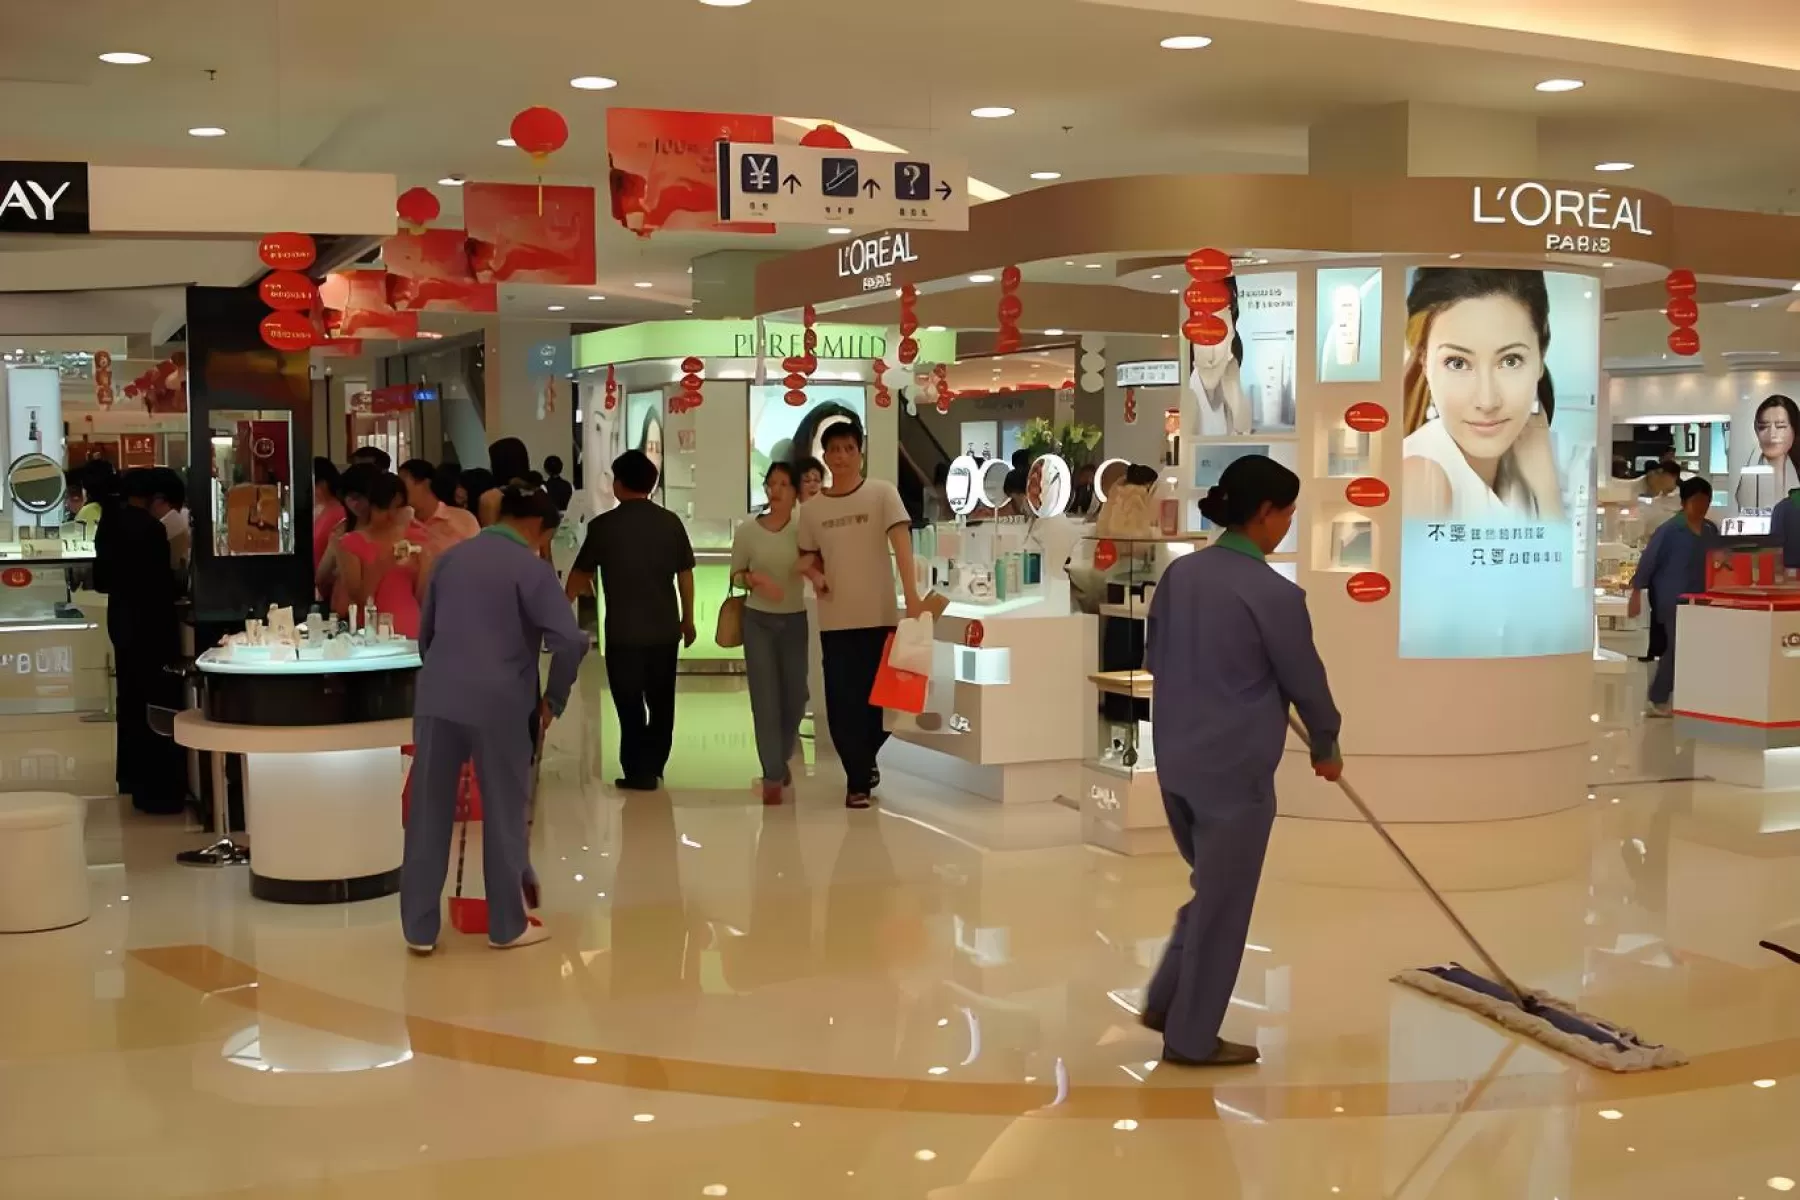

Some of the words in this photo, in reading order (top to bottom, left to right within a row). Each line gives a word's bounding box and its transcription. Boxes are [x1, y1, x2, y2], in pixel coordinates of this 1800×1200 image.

[0, 180, 71, 220] AY
[1473, 182, 1654, 236] L'ORÉAL
[838, 230, 918, 277] L'ORÉAL
